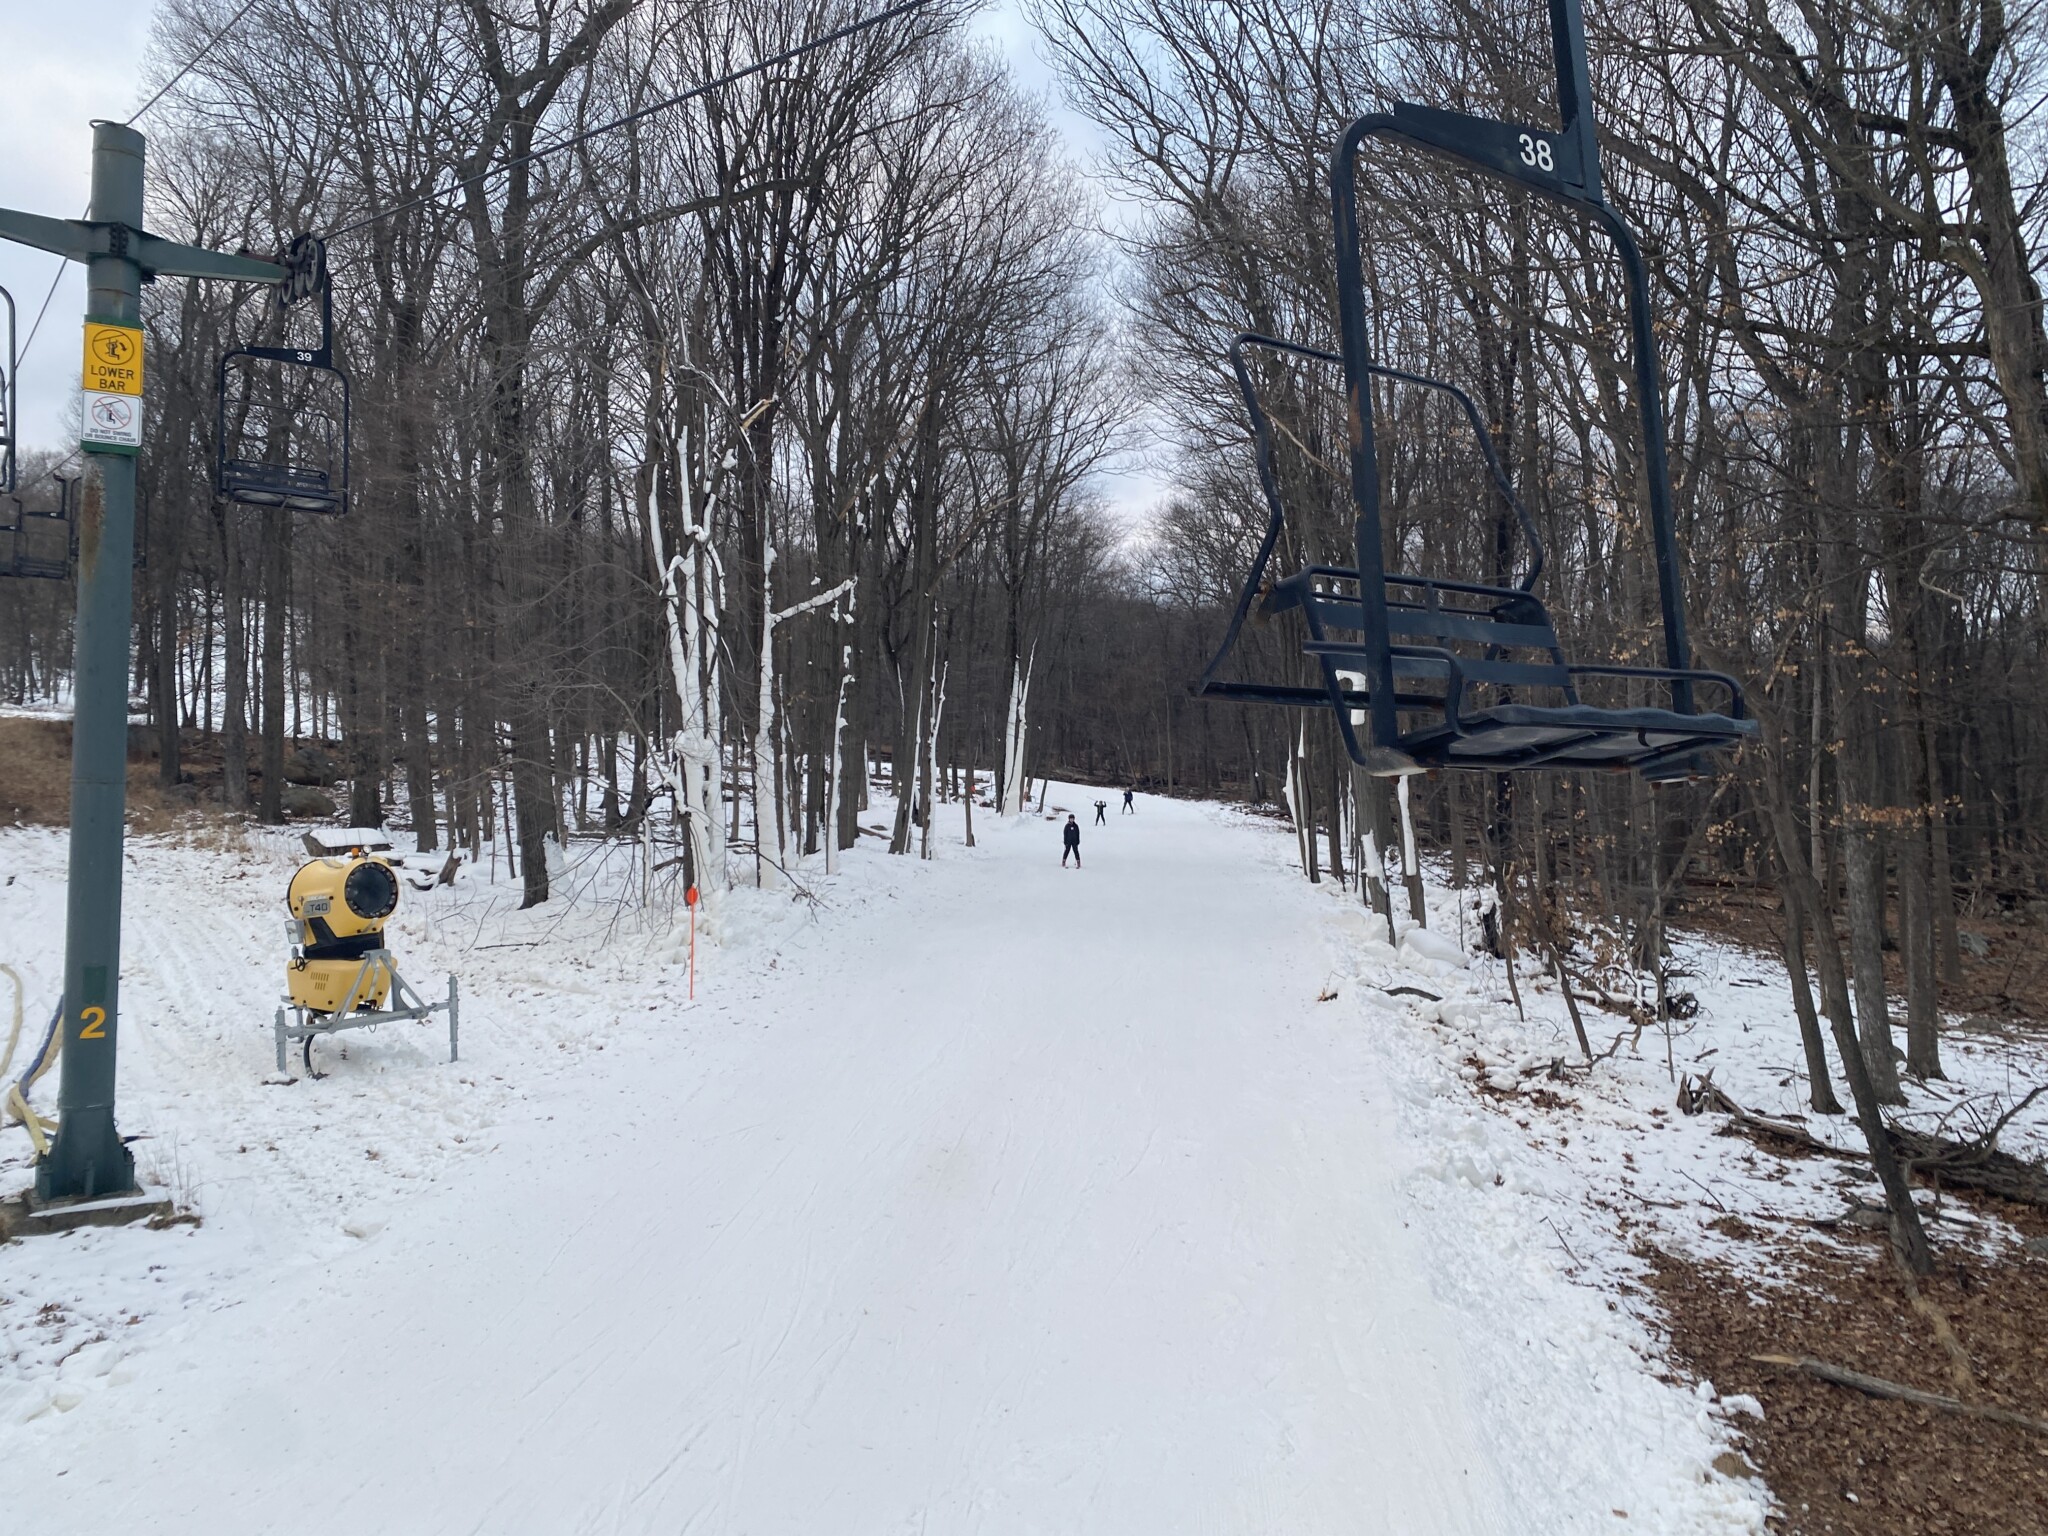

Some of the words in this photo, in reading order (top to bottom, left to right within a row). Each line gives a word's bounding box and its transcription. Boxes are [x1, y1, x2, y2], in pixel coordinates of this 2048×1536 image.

[1519, 133, 1554, 172] 38
[297, 351, 312, 362] 39
[90, 364, 135, 380] LOWER
[99, 378, 126, 391] BAR
[310, 902, 328, 912] T40
[79, 1006, 106, 1039] 2
